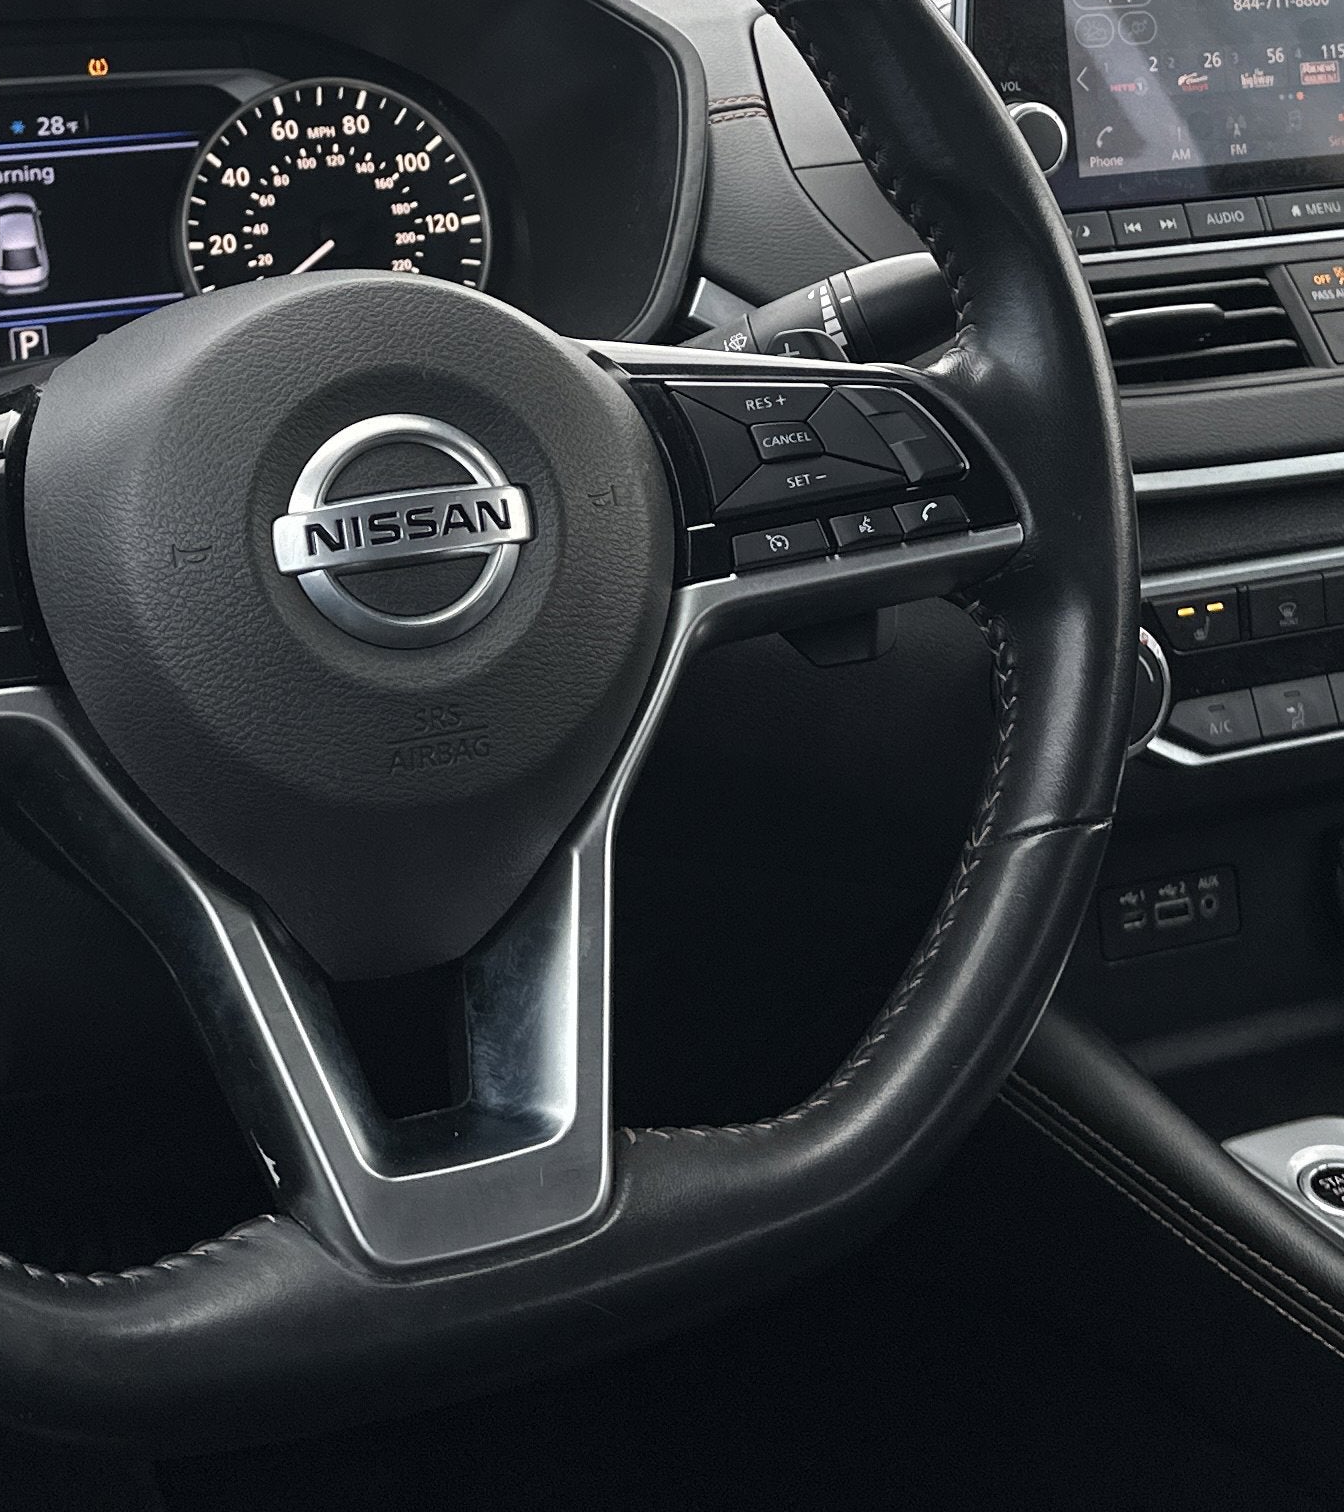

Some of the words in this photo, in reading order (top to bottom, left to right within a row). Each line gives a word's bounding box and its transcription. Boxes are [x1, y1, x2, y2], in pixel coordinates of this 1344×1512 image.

[1203, 51, 1222, 69] 26
[1266, 47, 1285, 65] 56
[1149, 56, 1159, 73] 2
[1001, 81, 1022, 92] VOL
[271, 119, 299, 140] 60
[307, 125, 336, 138] MPH
[342, 114, 370, 135] 80
[1172, 149, 1191, 161] AM
[1230, 143, 1248, 156] FM
[296, 157, 317, 170] 100
[325, 154, 345, 167] 120
[355, 161, 375, 174] 140
[396, 151, 430, 173] 100
[1090, 155, 1124, 168] Phone
[221, 167, 250, 188] 40
[273, 174, 290, 187] 80
[374, 177, 394, 189] 160
[259, 194, 275, 207] 60
[1305, 201, 1341, 216] MENU
[425, 212, 459, 234] 120
[1206, 210, 1245, 225] AUDIO
[253, 222, 269, 236] 40
[209, 233, 238, 255] 20
[395, 232, 416, 245] 200
[257, 253, 273, 266] 20
[391, 258, 413, 271] 220
[1313, 273, 1332, 286] OFF
[1311, 289, 1336, 301] PASS
[19, 330, 40, 360] P
[745, 395, 774, 412] RES
[762, 432, 812, 448] CANCEL
[786, 473, 811, 490] SET
[305, 497, 512, 557] NISSAN
[414, 705, 462, 734] SRS
[1209, 719, 1234, 735] A/C
[389, 735, 490, 775] AIRBAG
